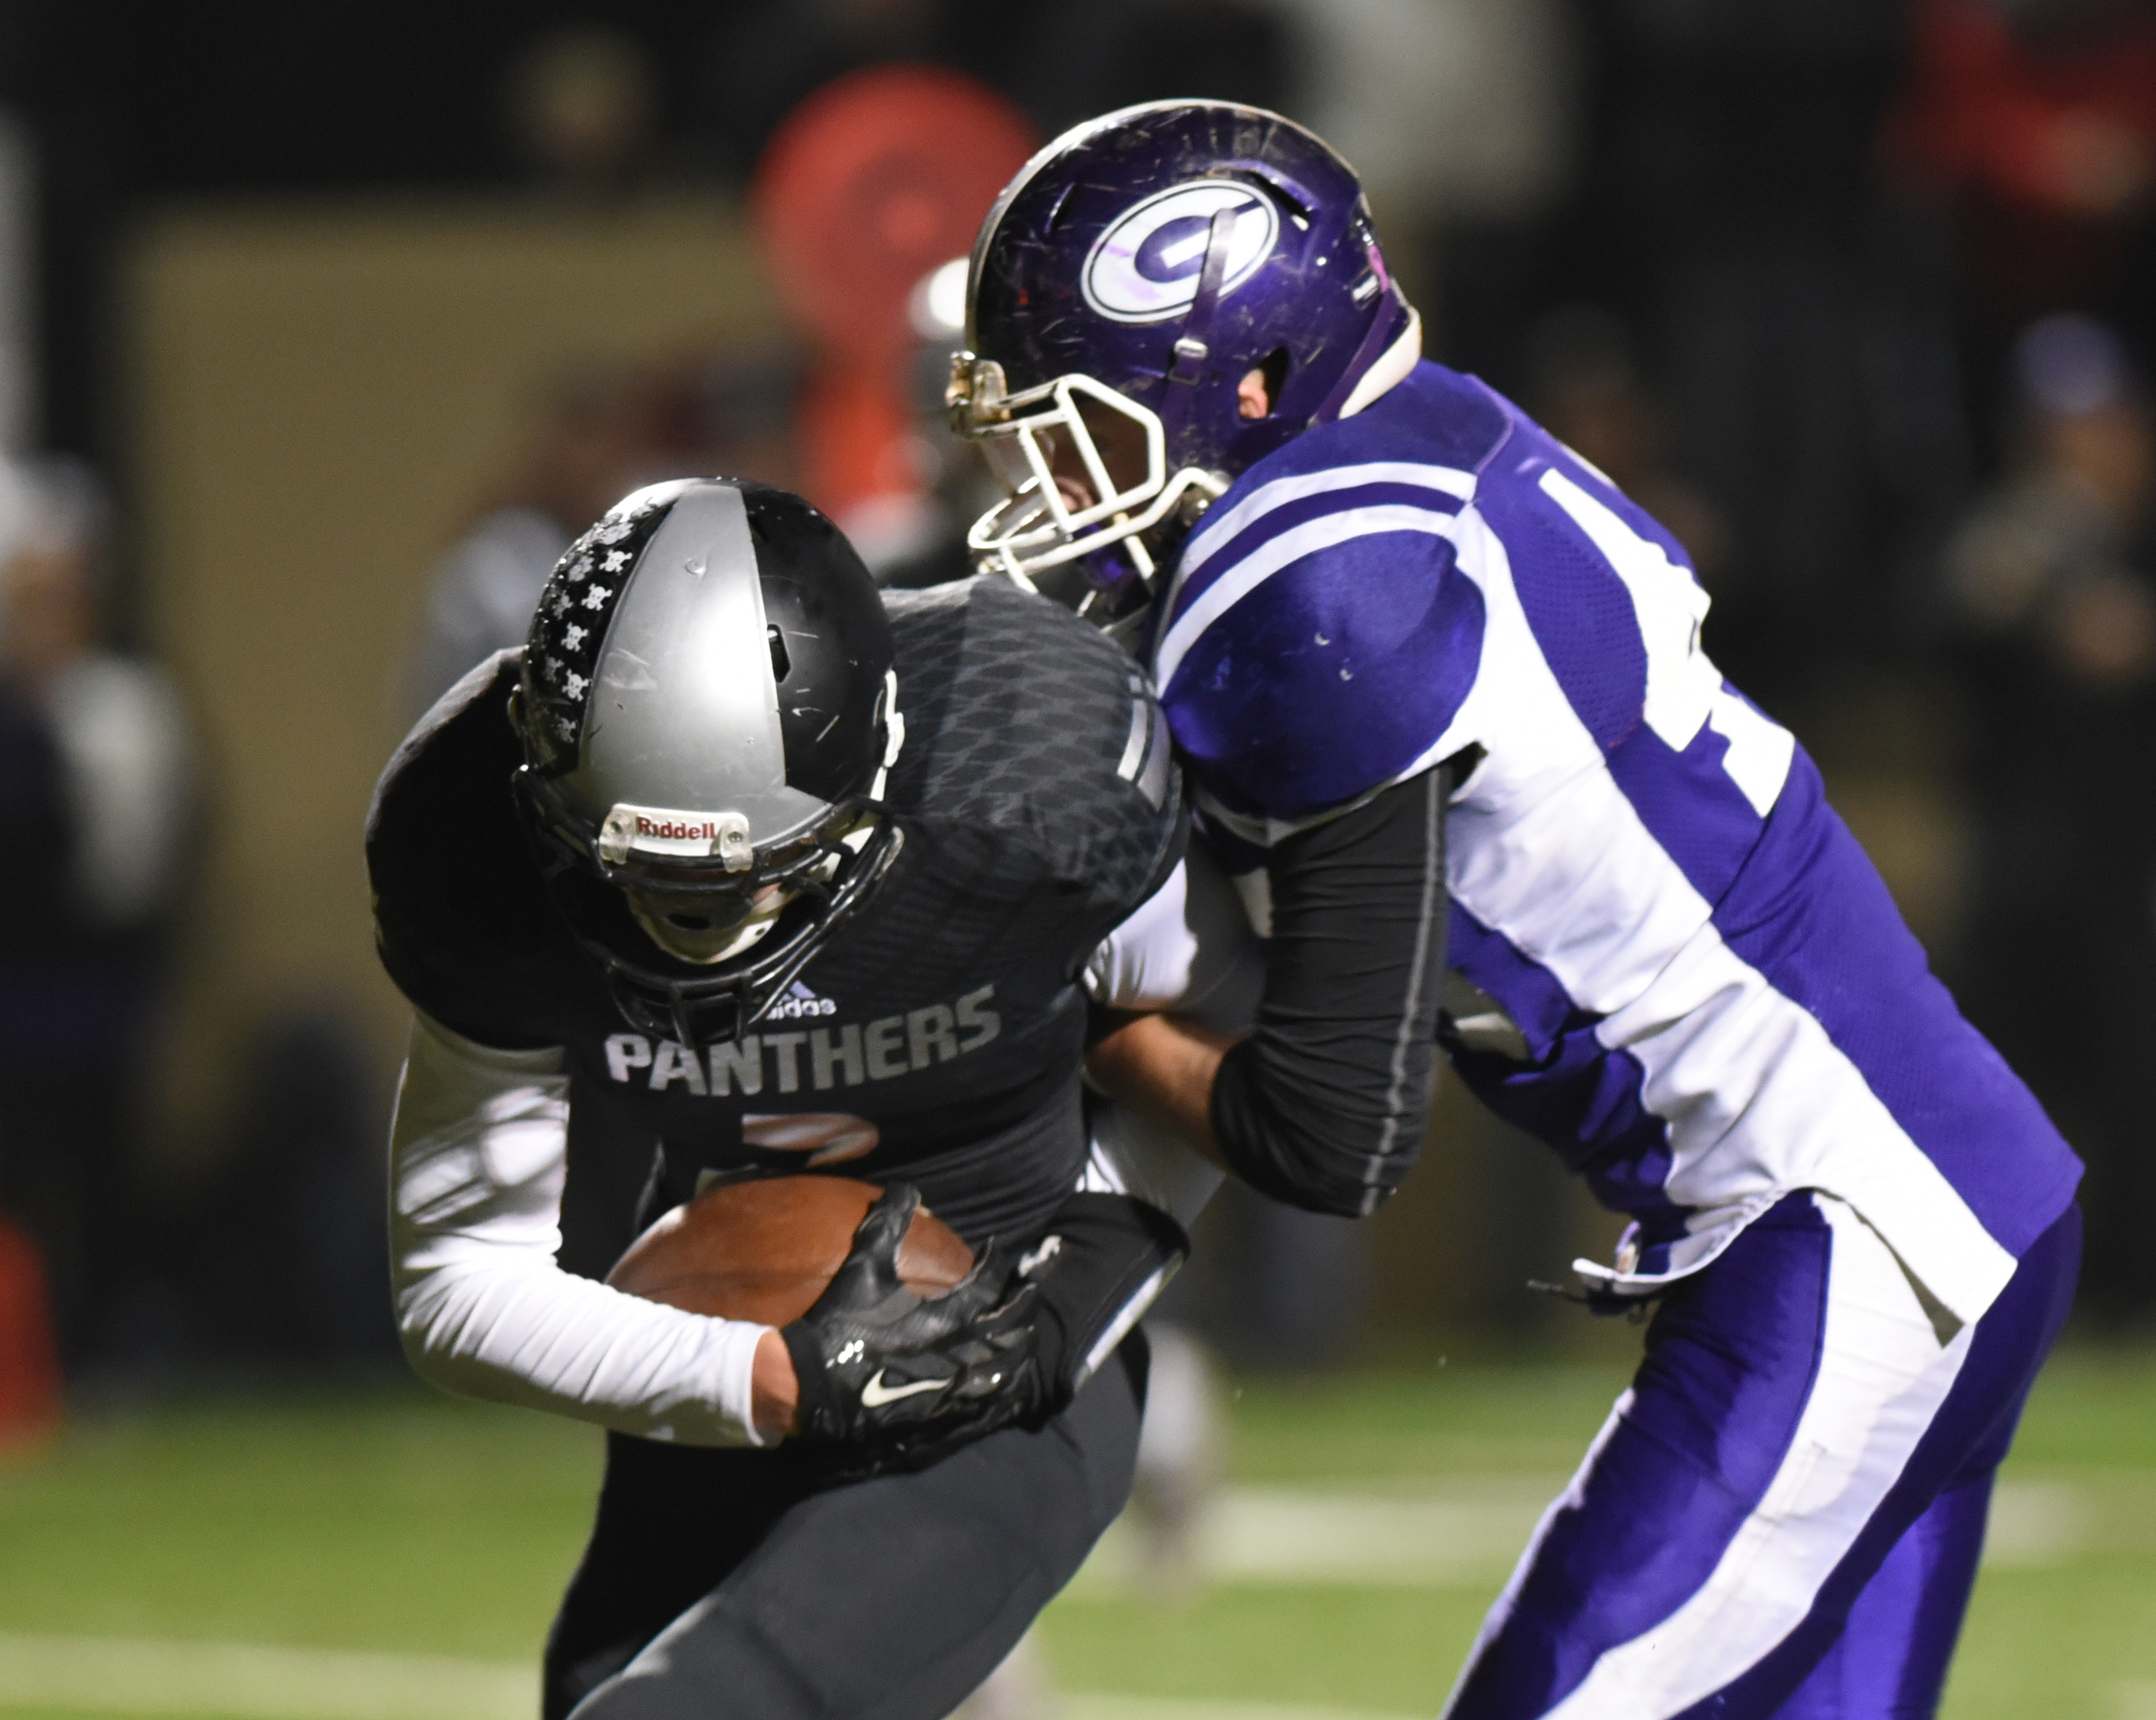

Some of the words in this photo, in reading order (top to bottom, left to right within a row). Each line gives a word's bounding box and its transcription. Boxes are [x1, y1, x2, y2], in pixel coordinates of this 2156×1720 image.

[1089, 186, 1272, 314] G
[635, 815, 717, 840] Riddell
[604, 983, 1003, 1097] PANTHERS
